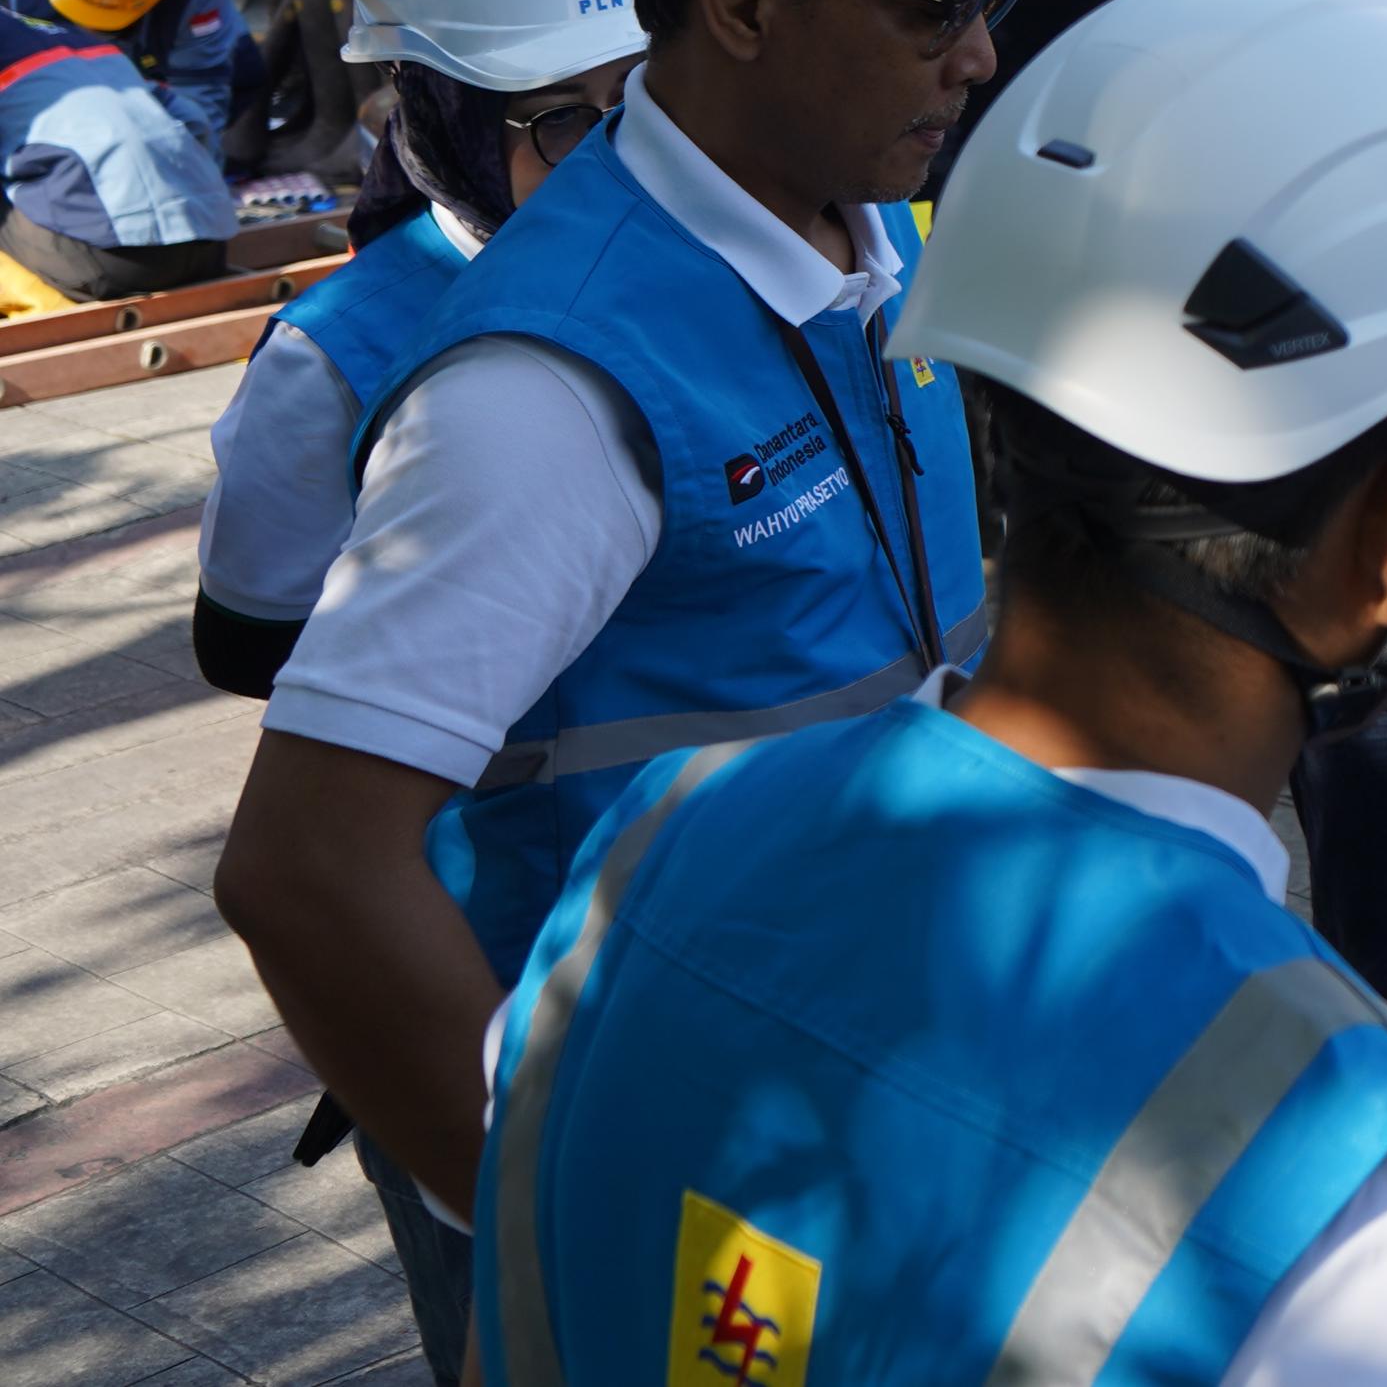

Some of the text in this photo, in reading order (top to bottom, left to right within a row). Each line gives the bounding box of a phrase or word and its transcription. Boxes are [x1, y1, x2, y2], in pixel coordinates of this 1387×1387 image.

[754, 412, 820, 463] Danantara
[766, 435, 827, 486] Indonesia
[734, 467, 849, 548] WAHYU PRASETYO
